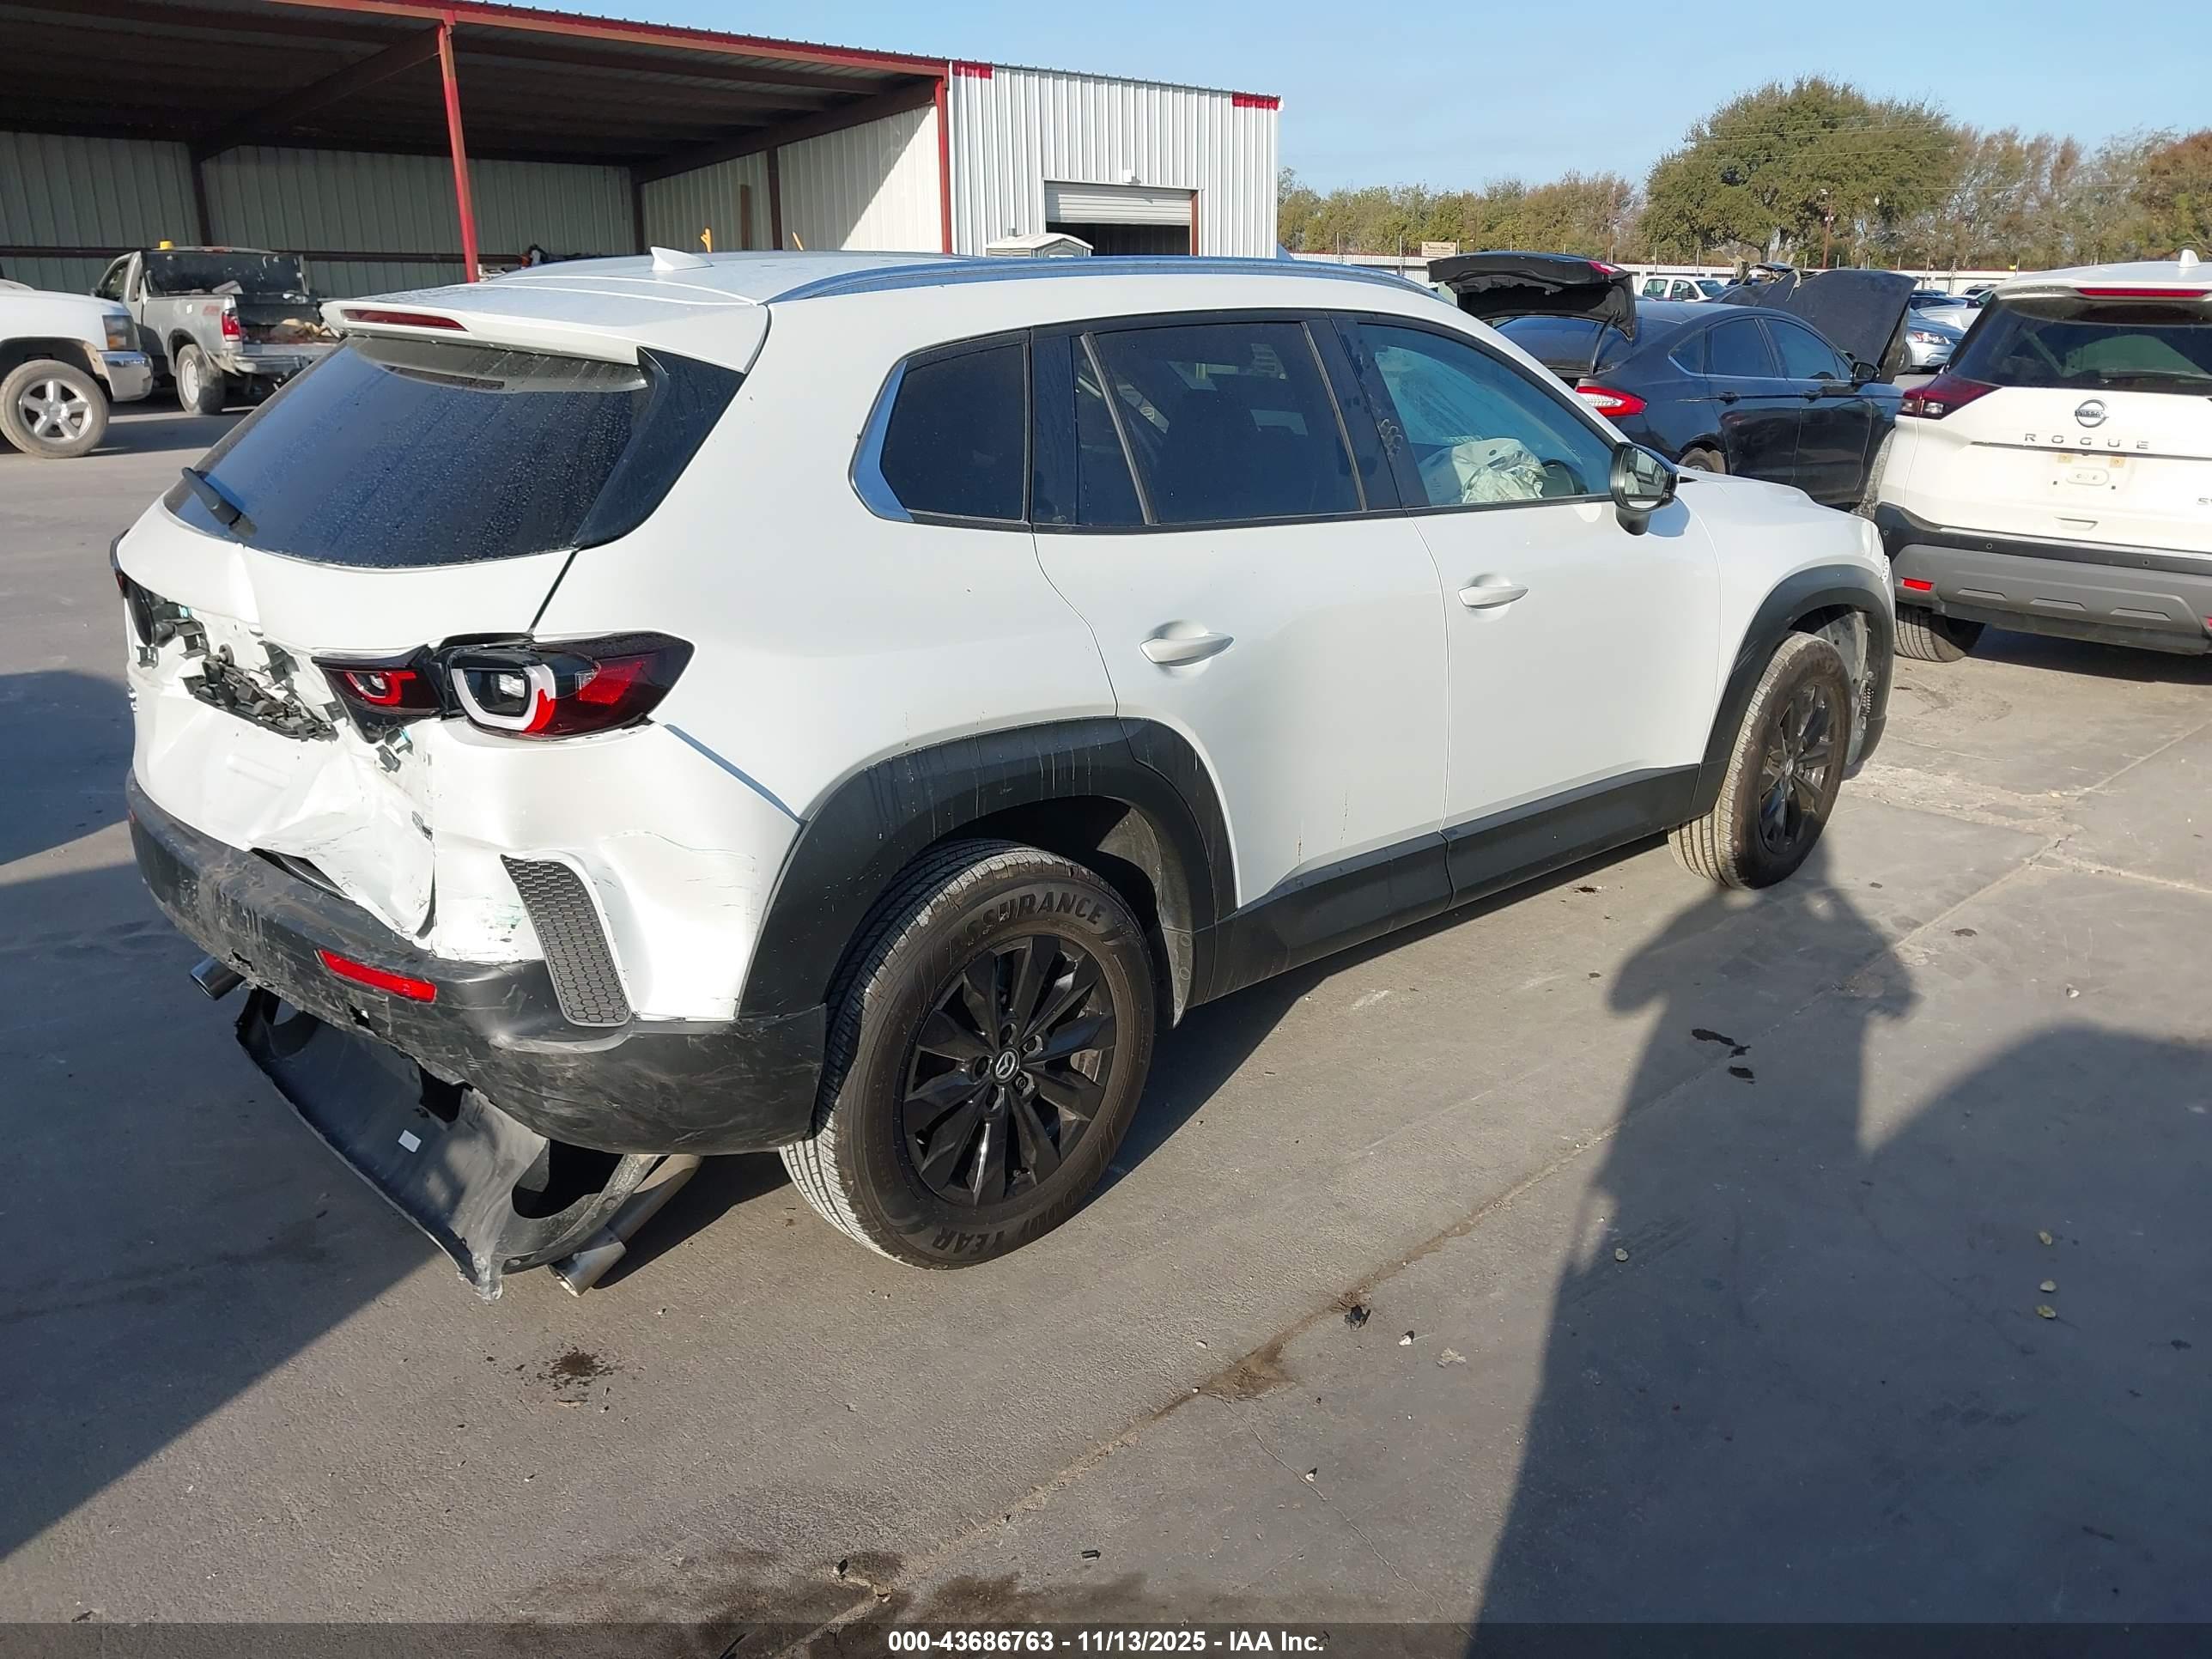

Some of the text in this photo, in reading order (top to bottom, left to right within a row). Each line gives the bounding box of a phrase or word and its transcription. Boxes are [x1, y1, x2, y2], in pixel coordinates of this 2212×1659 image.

[2024, 433, 2149, 450] ROGUE
[2197, 497, 2212, 507] S
[933, 1225, 1005, 1255] YEAR
